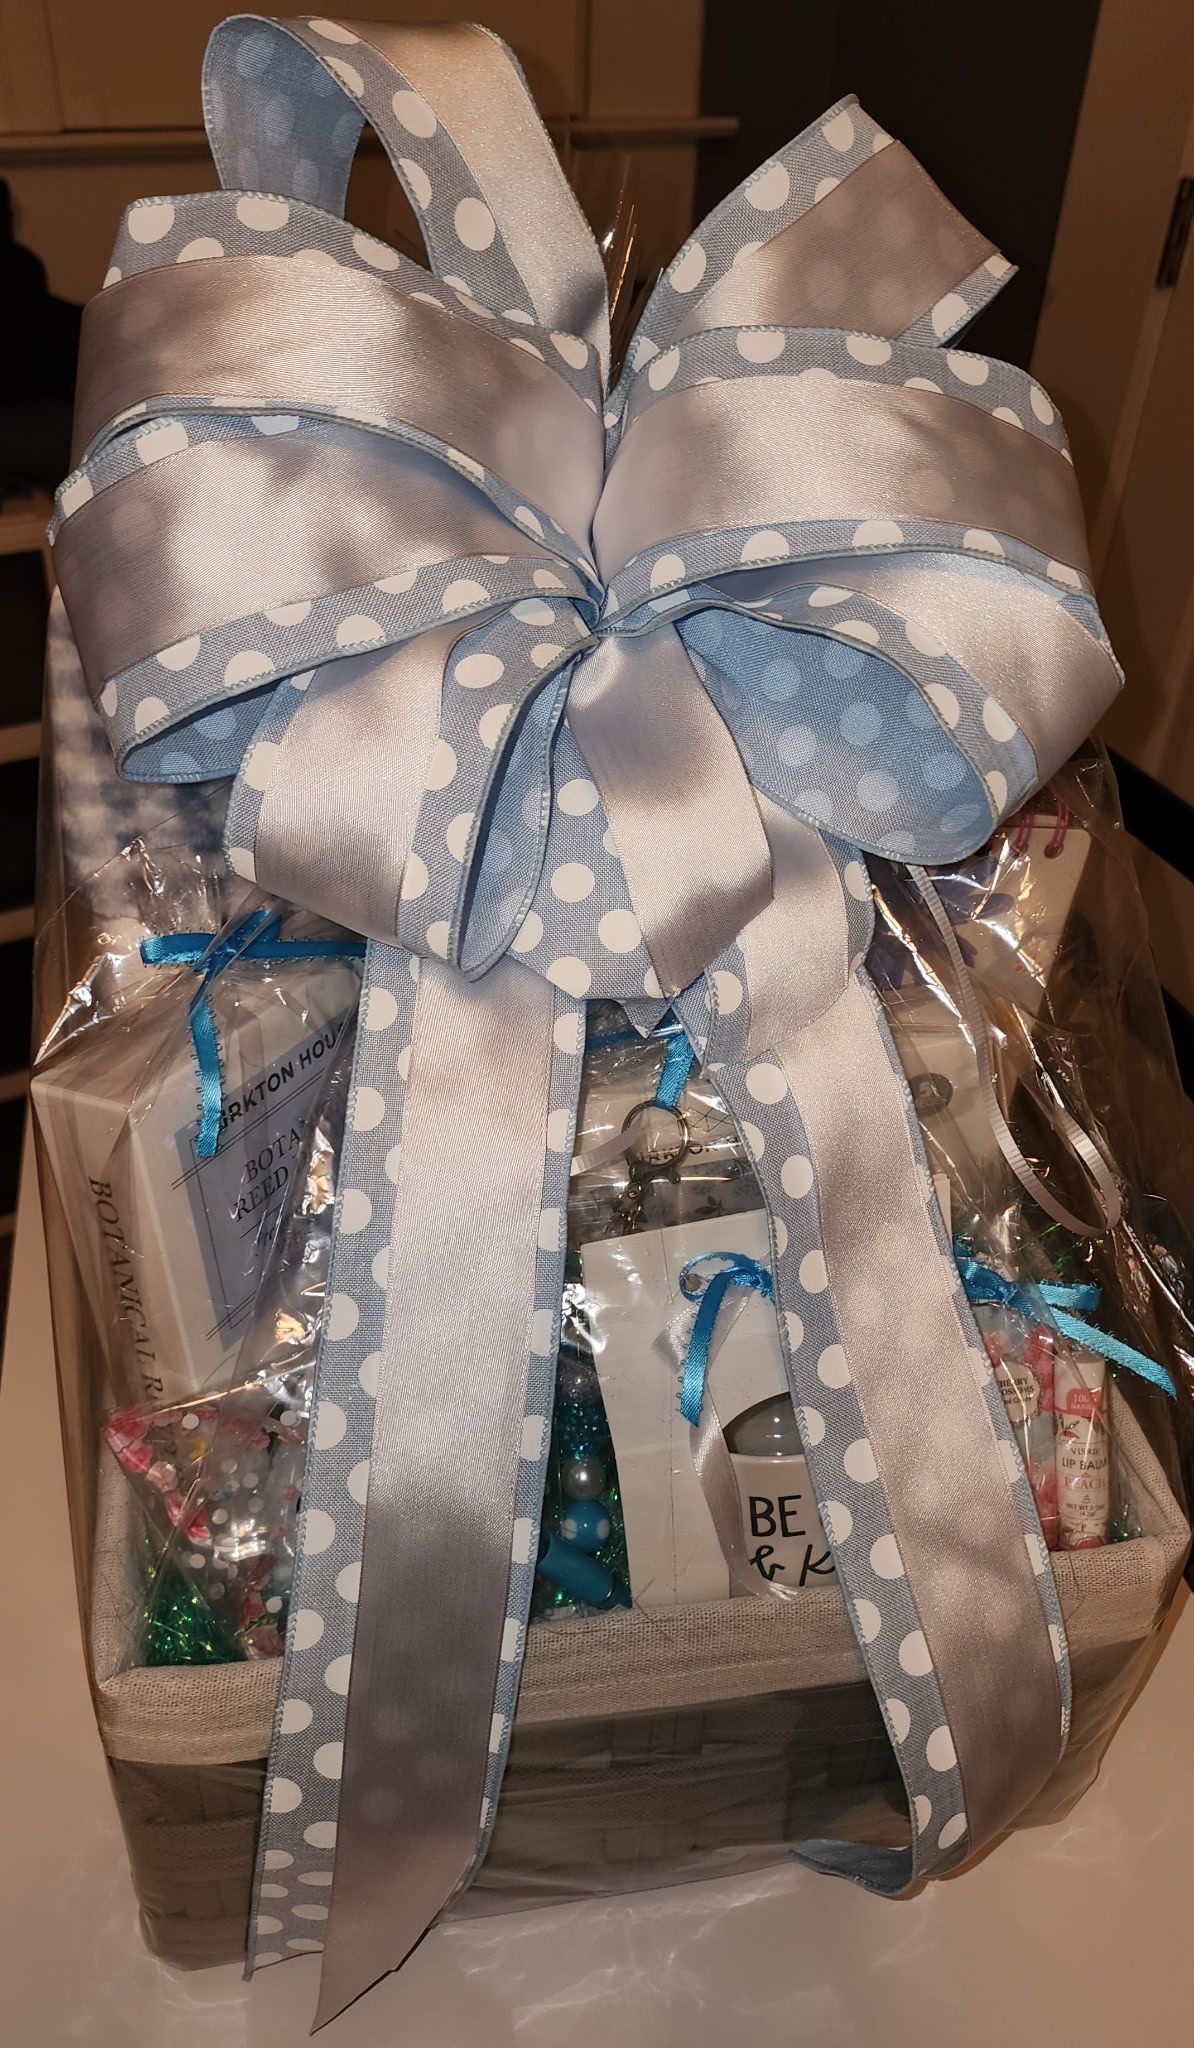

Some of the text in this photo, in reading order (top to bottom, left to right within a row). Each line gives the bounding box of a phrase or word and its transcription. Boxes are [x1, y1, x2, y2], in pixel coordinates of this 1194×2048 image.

[299, 1022, 344, 1070] HOU
[244, 1127, 300, 1184] BOTA
[233, 1166, 289, 1223] REED
[89, 1176, 156, 1364] BOTANICAL
[749, 1494, 806, 1538] BE
